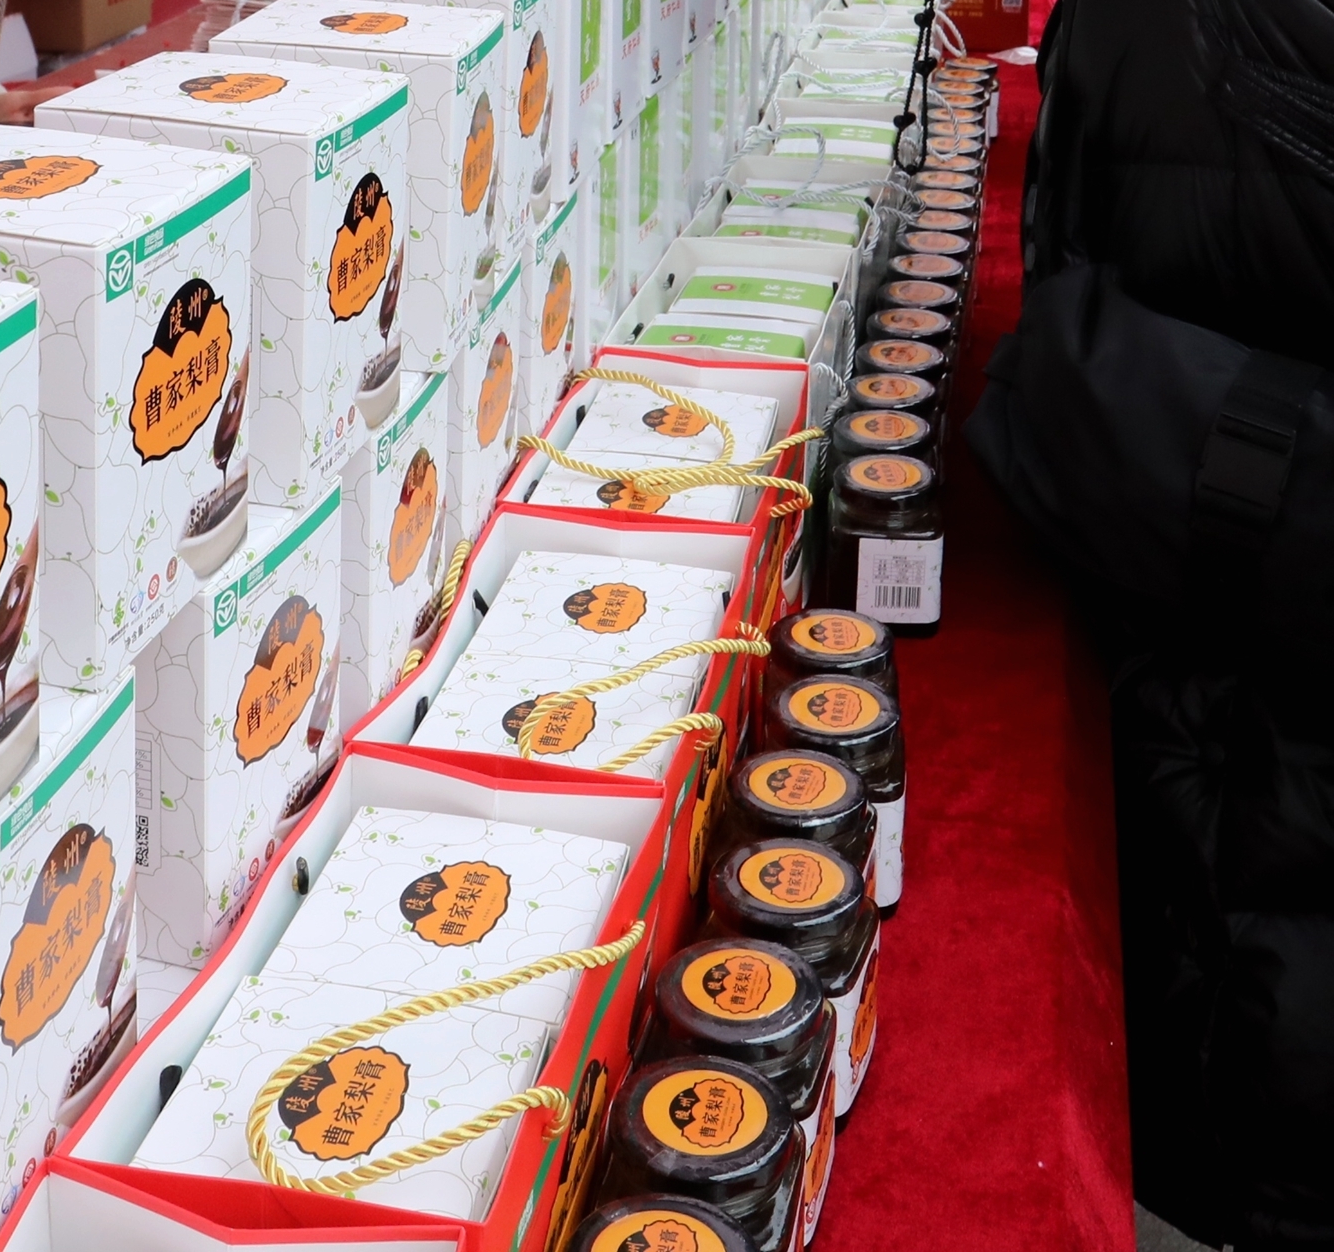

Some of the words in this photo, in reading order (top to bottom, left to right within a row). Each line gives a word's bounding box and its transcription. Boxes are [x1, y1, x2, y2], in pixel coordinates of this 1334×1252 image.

[336, 224, 387, 296] 曹家梨膏
[169, 287, 203, 340] 陵州
[144, 336, 221, 432] 曹家梨膏
[596, 588, 631, 628] 曹家梨膏
[246, 639, 316, 740] 曹家梨膏
[41, 832, 80, 906] 陵州
[404, 881, 438, 911] 陵州
[785, 859, 807, 897] 曹家梨膏
[439, 870, 491, 936] 曹家梨膏
[14, 870, 104, 1018] 曹家梨膏
[729, 961, 756, 1006] 曹家梨膏
[284, 1074, 324, 1113] 陵州
[321, 1059, 387, 1147] 曹家梨膏
[698, 1086, 727, 1139] 曹家梨膏
